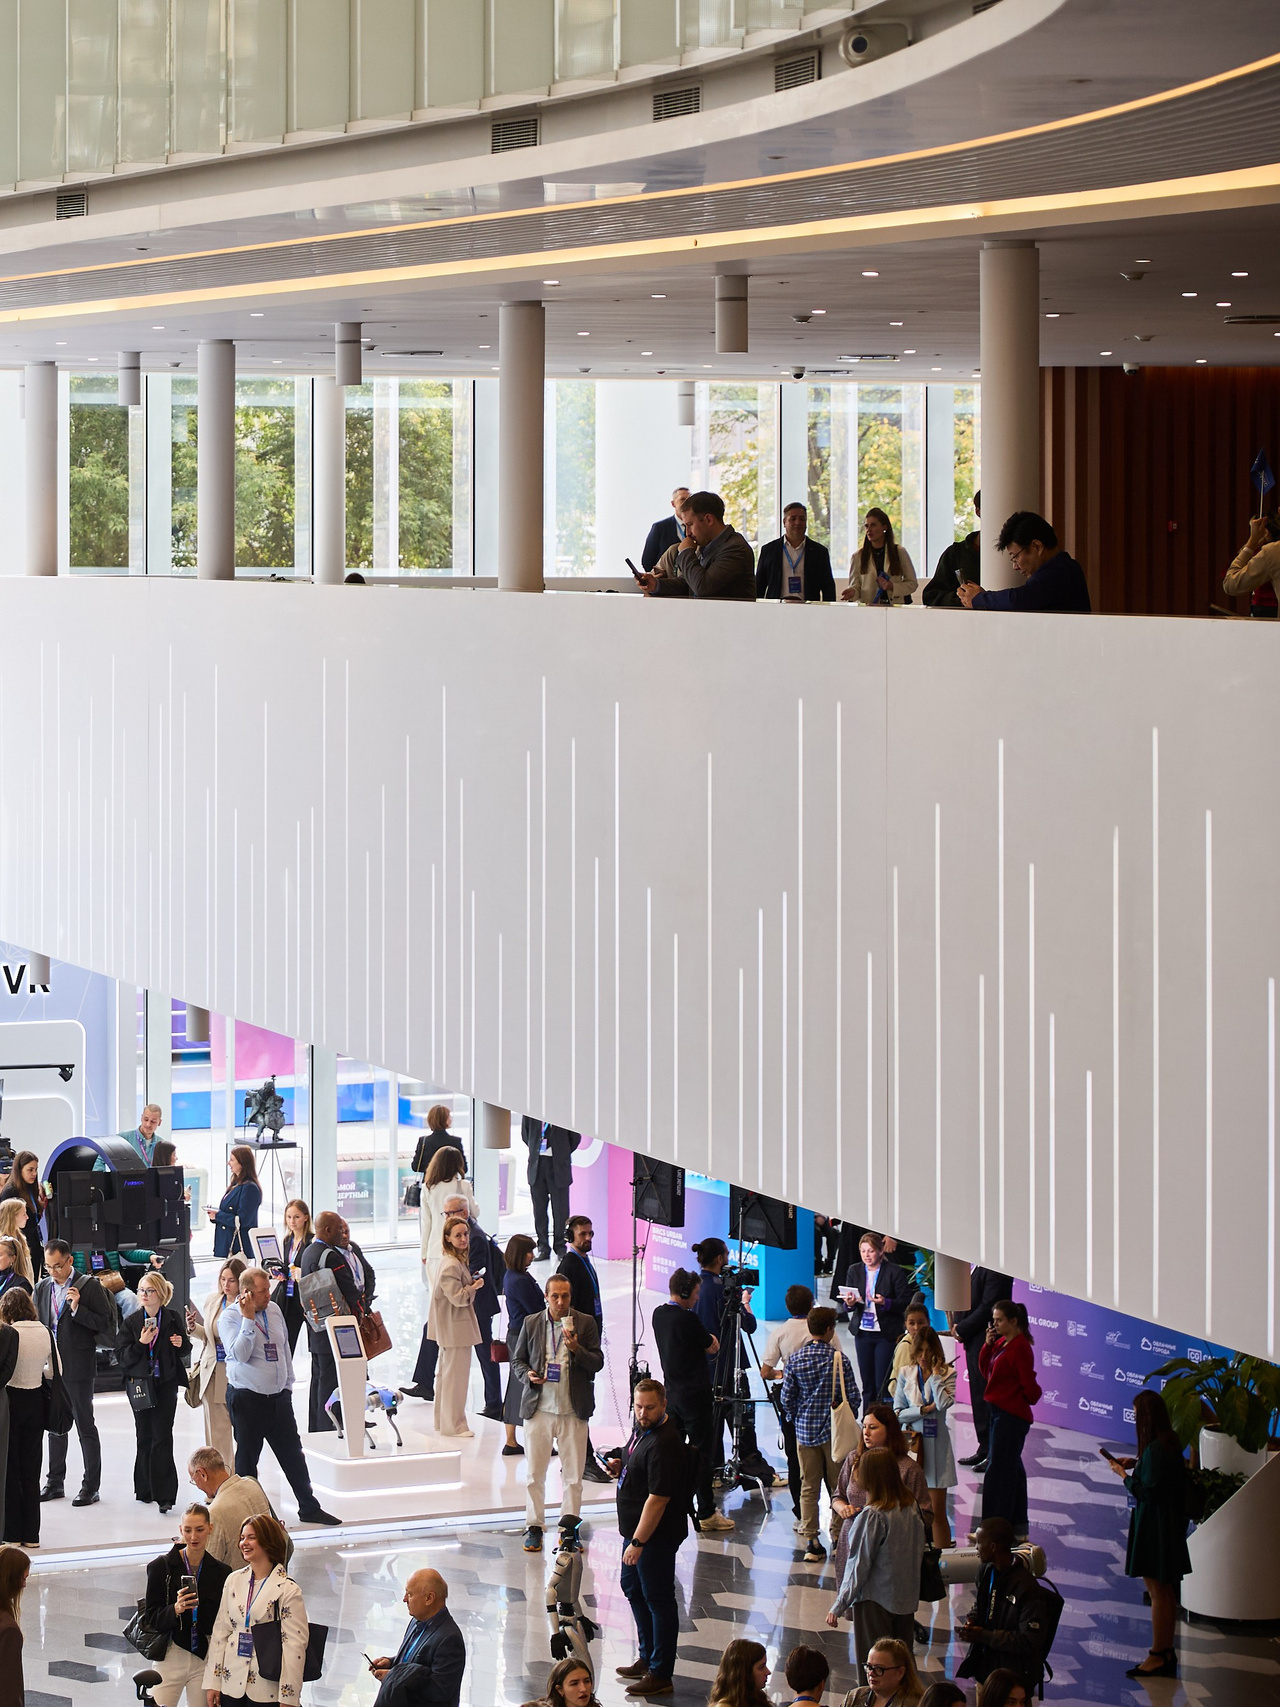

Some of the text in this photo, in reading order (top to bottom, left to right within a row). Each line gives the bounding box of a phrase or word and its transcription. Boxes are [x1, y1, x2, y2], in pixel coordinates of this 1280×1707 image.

[3, 964, 50, 994] V
[652, 1226, 683, 1240] BRICS URBAN
[652, 1235, 688, 1250] FUTURE FORUM
[1038, 1318, 1059, 1330] GROUP
